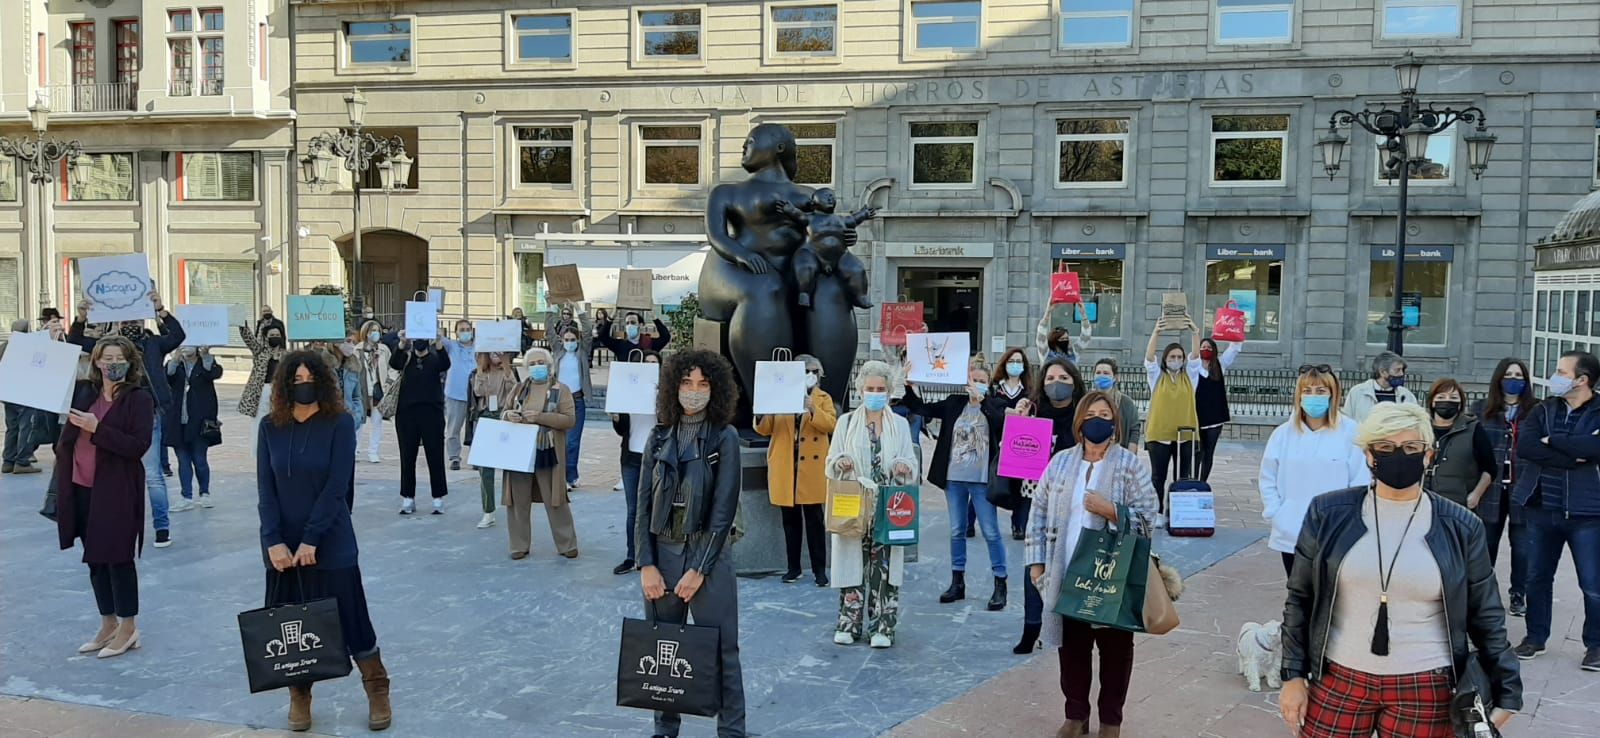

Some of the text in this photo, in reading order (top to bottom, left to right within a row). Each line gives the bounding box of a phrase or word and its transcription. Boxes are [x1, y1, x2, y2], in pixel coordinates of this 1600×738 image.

[669, 85, 747, 104] CAJA
[776, 84, 808, 103] DE
[839, 80, 985, 102] AHORROS
[1015, 78, 1050, 98] DE
[914, 245, 965, 256] Liberbank
[651, 273, 690, 282] Liberbank
[294, 311, 338, 321] SAN COCO
[1074, 576, 1093, 591] Loli
